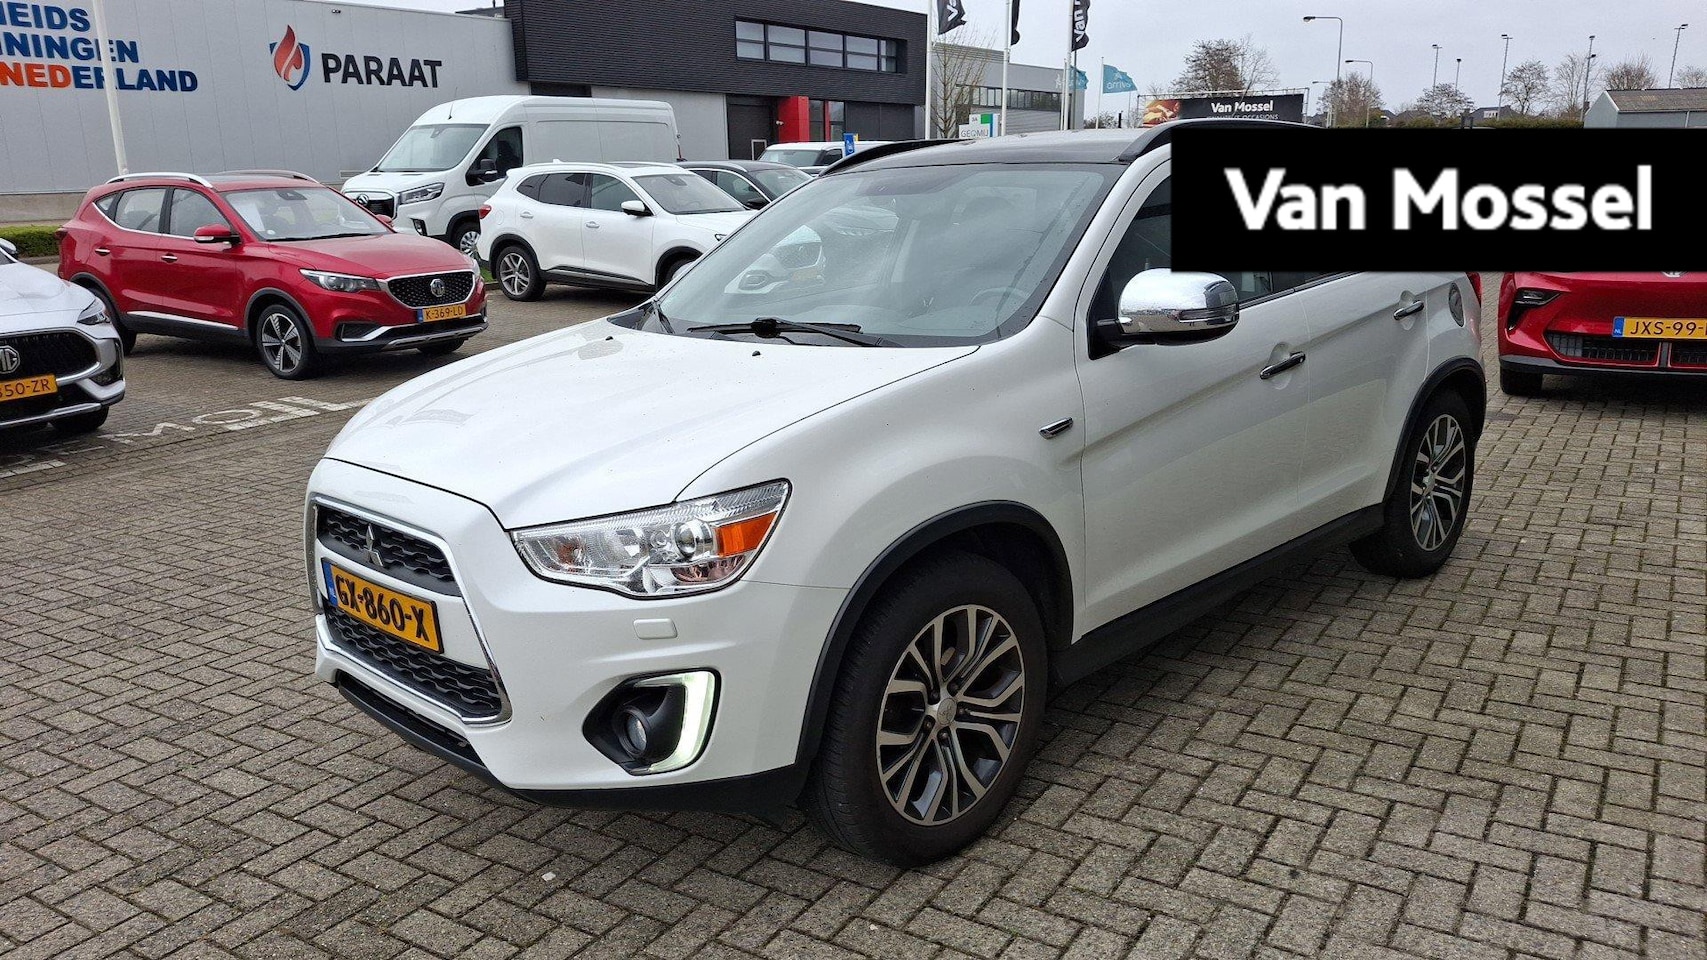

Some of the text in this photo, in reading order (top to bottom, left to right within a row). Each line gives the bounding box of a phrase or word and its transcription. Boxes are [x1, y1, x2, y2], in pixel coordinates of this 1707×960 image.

[1073, 9, 1086, 42] Van
[0, 32, 139, 63] NINGEN
[321, 53, 442, 88] PARAAT
[1211, 100, 1274, 113] Van Mossel
[1630, 321, 1707, 336] JXS-99-
[0, 379, 51, 398] 50-ZR
[335, 574, 430, 642] GX-860-X
